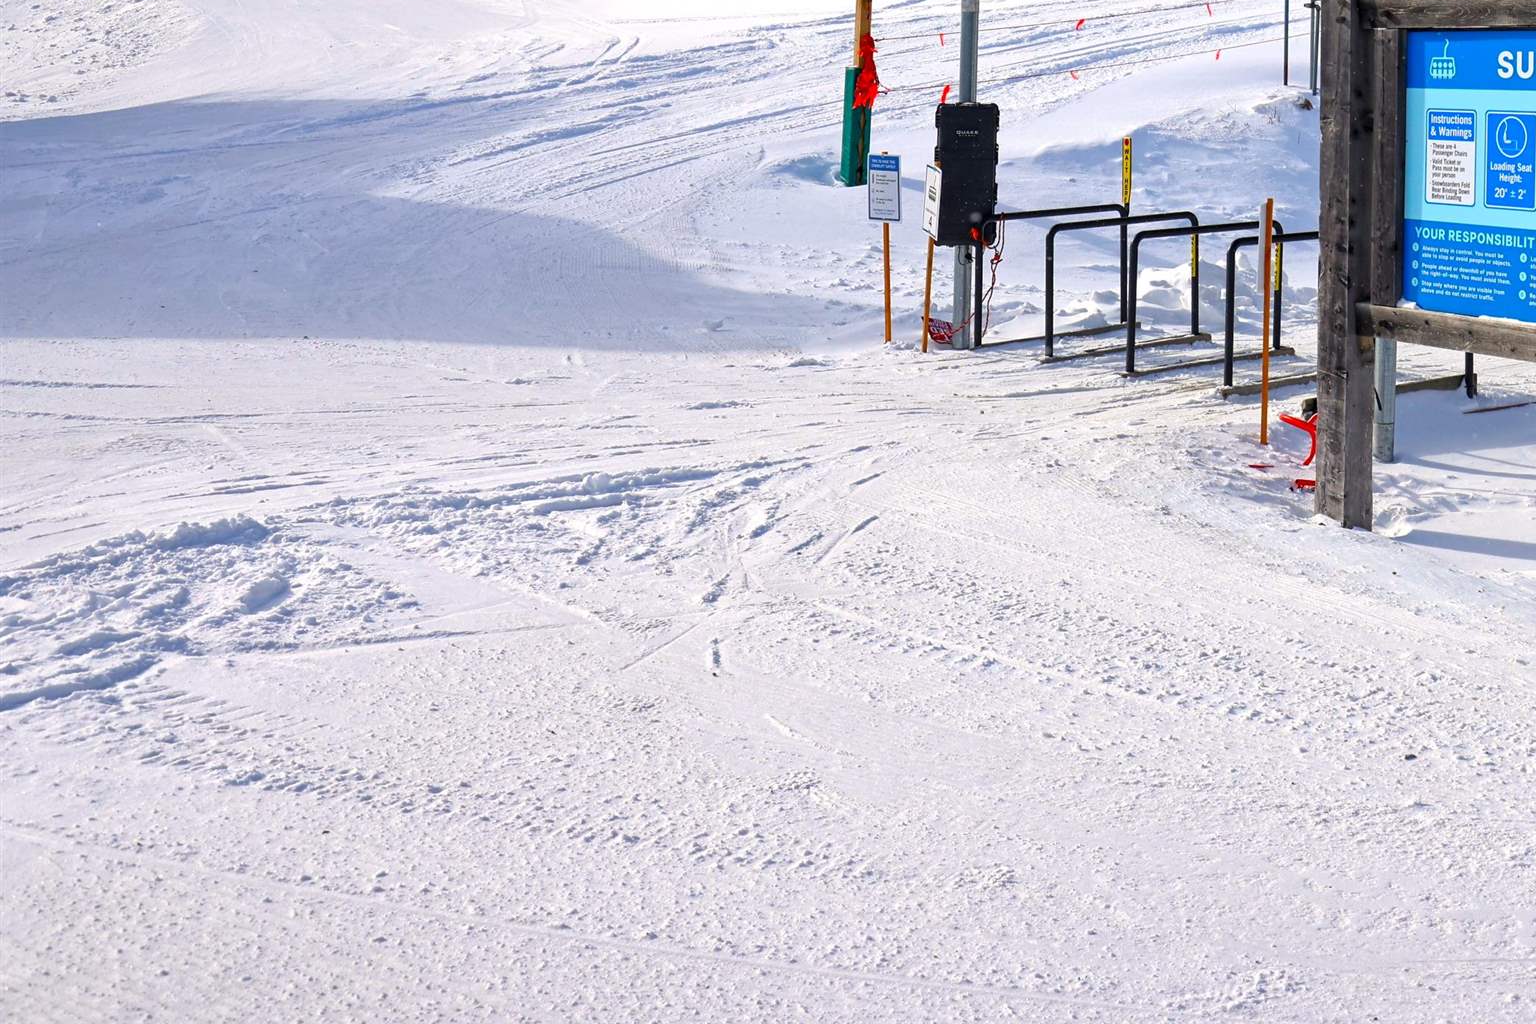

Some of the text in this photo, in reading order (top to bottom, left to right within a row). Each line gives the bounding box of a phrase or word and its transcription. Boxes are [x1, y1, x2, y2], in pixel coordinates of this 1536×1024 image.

[1431, 114, 1472, 124] Instructions
[1431, 127, 1472, 139] & Warnings
[1490, 161, 1532, 173] Loading Seat
[1499, 173, 1522, 184] Height:
[1415, 226, 1445, 240] YOUR
